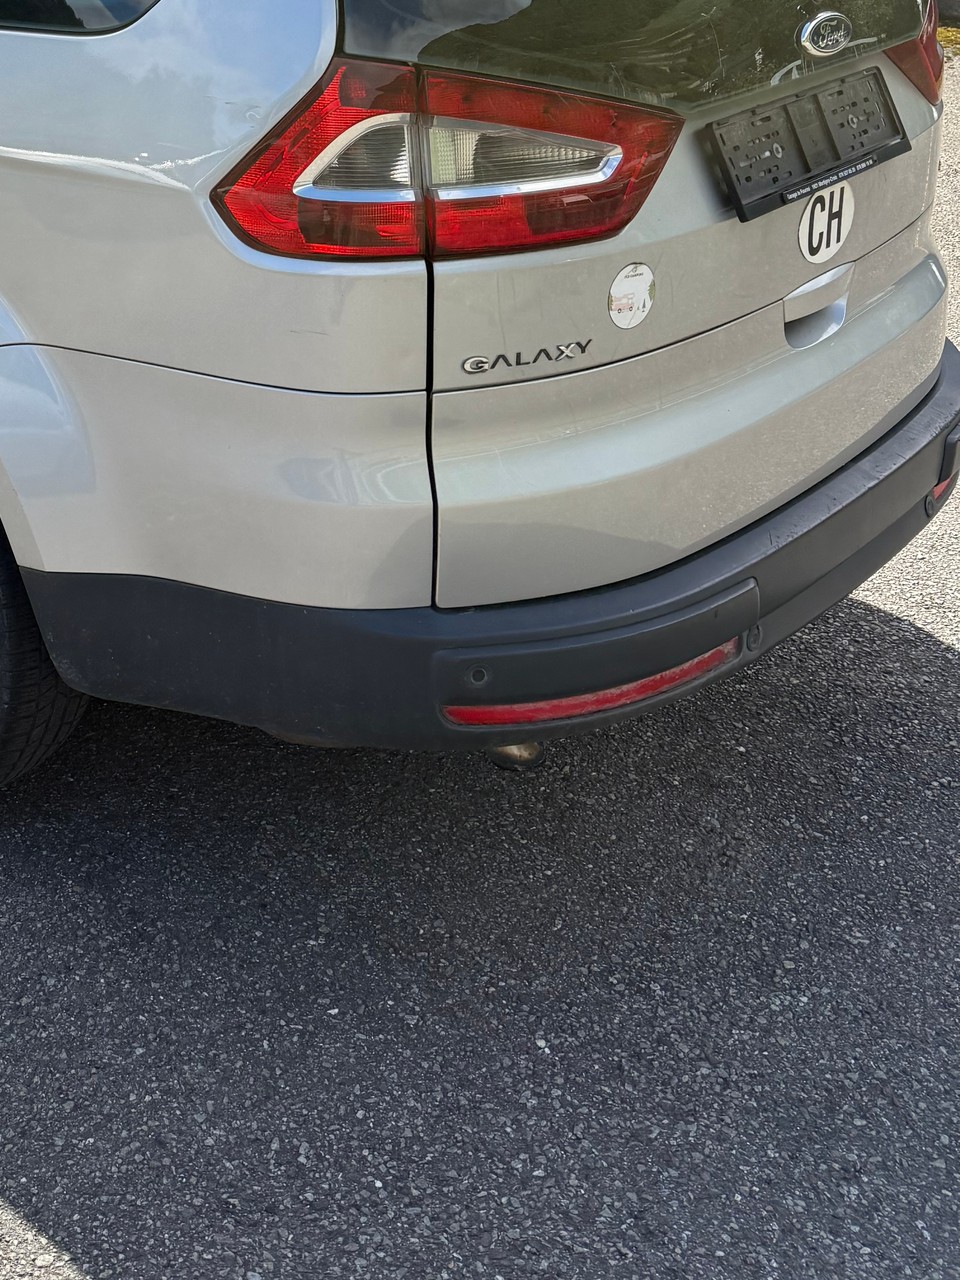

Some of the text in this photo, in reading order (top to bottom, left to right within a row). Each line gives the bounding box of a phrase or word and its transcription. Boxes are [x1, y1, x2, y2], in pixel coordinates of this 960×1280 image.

[816, 20, 847, 48] Ford
[808, 186, 845, 256] CH
[461, 339, 592, 374] GALAXY
